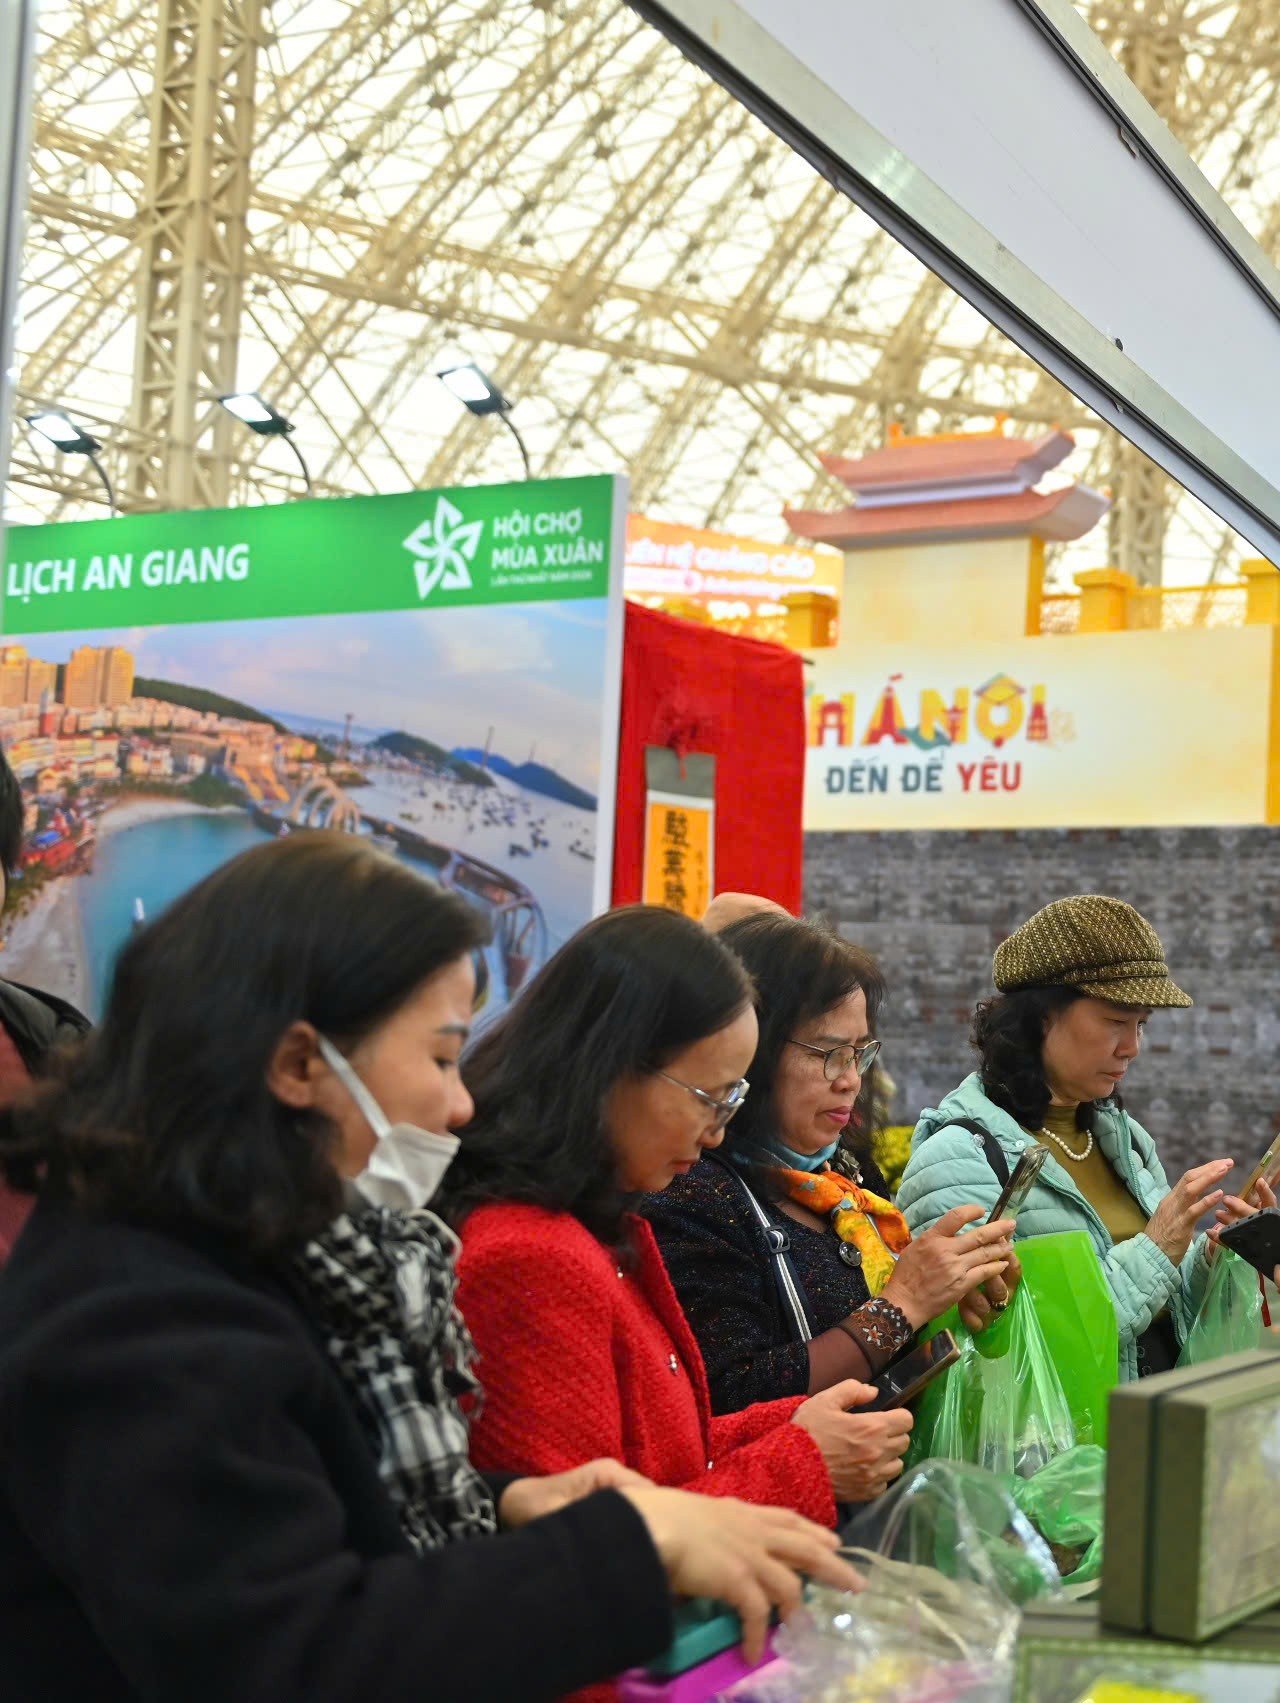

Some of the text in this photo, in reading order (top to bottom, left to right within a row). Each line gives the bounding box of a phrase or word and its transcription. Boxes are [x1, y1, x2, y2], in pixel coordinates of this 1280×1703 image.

[493, 507, 583, 538] HỘI CHỢ
[491, 536, 604, 570] MÙA XUÂN
[7, 543, 249, 603] LỊCH AN GIANG
[957, 755, 1022, 792] YÊU
